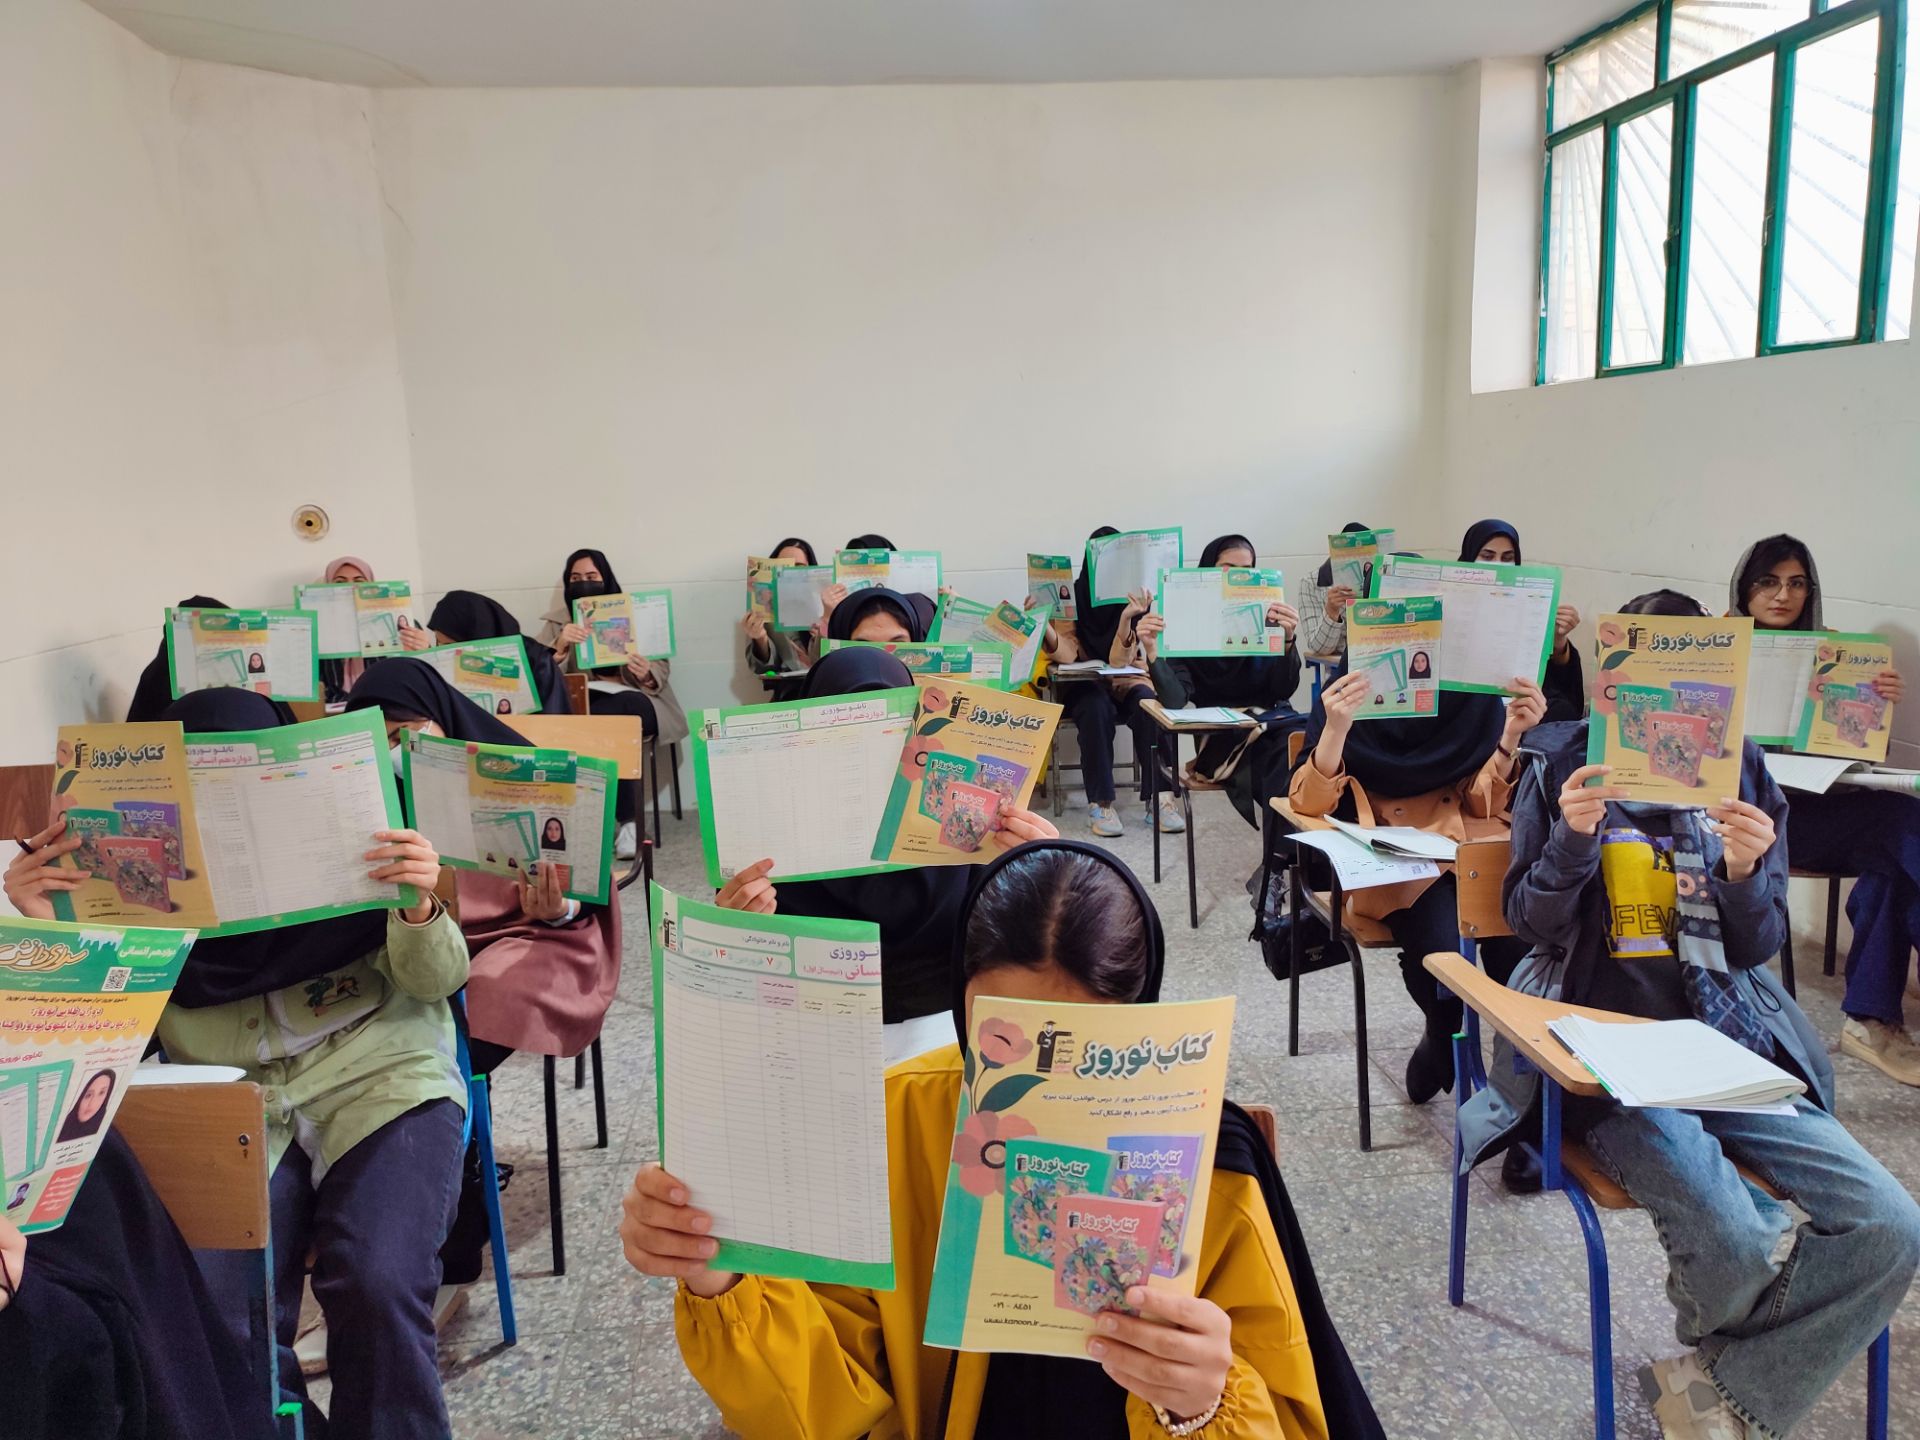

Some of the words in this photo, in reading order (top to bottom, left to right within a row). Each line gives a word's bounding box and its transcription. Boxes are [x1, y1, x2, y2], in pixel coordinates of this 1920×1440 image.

[1650, 633, 1694, 653] نوروز
[1695, 633, 1736, 652] کتاب
[968, 706, 1009, 728] نوروز
[1009, 715, 1045, 731] کتاب
[90, 744, 129, 769] نوروز
[130, 743, 165, 766] کتاب
[766, 956, 774, 966] ۷
[829, 944, 880, 962] نوروزی
[1076, 1038, 1152, 1079] نوروز
[1155, 1030, 1215, 1073] کتاب
[1028, 1155, 1060, 1175] نوروز
[1060, 1161, 1090, 1177] کتاب
[1130, 1150, 1160, 1170] نوروز
[1160, 1150, 1183, 1169] کتاب
[1080, 1212, 1112, 1233] نوروز
[1112, 1217, 1140, 1233] کتاب
